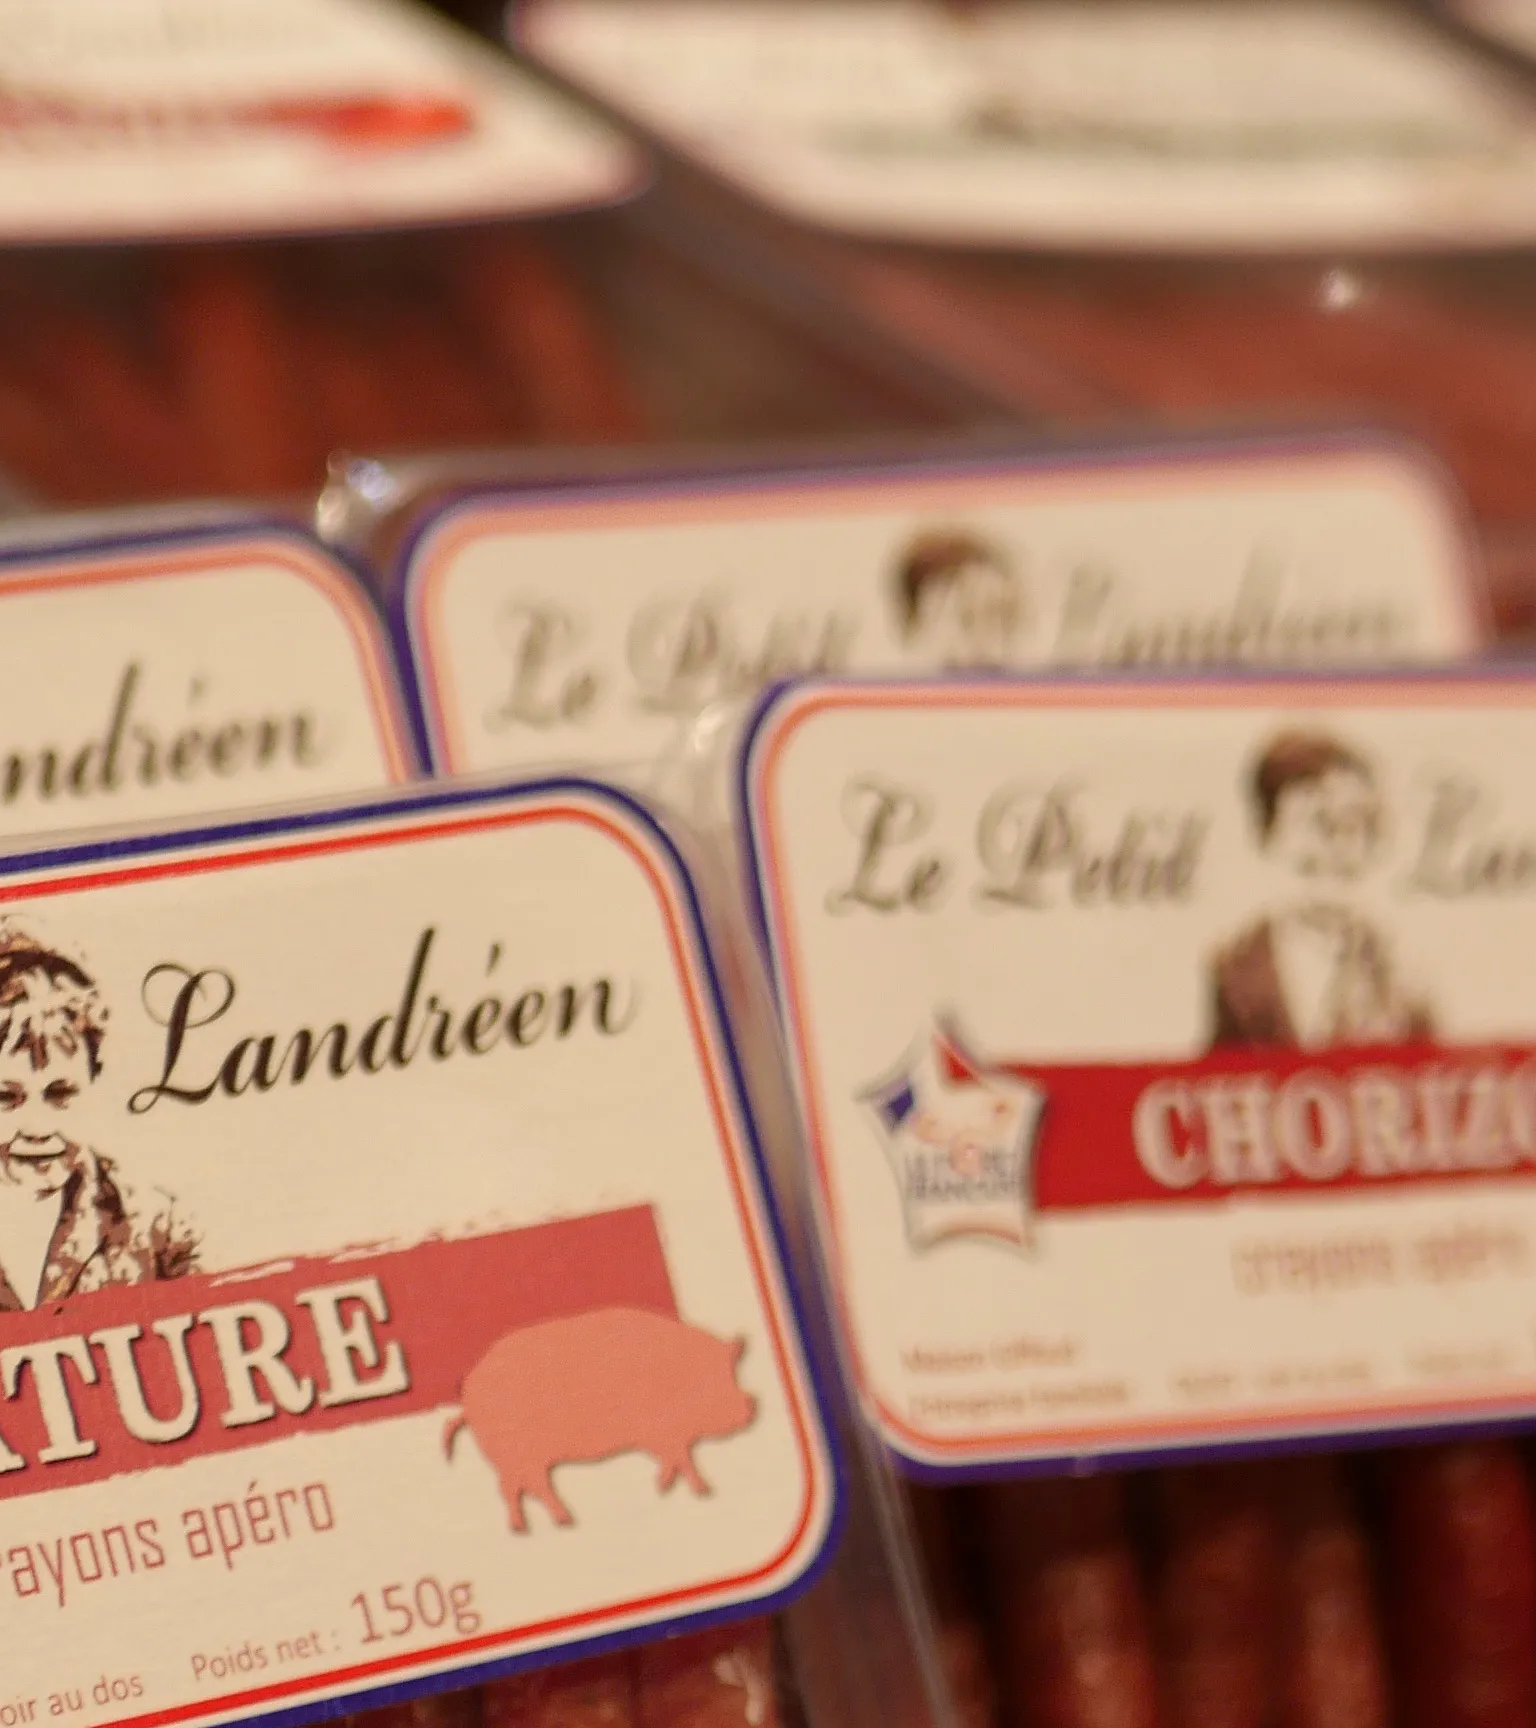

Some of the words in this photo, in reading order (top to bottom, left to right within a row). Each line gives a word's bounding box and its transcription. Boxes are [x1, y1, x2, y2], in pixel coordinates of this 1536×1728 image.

[825, 776, 951, 915] Le
[126, 925, 639, 1115] Landréen
[181, 1480, 336, 1570] apéro
[190, 1641, 269, 1683] Poids
[276, 1629, 325, 1664] net
[351, 1576, 485, 1648] 150g
[49, 1691, 84, 1719] au
[93, 1674, 145, 1708] dos
